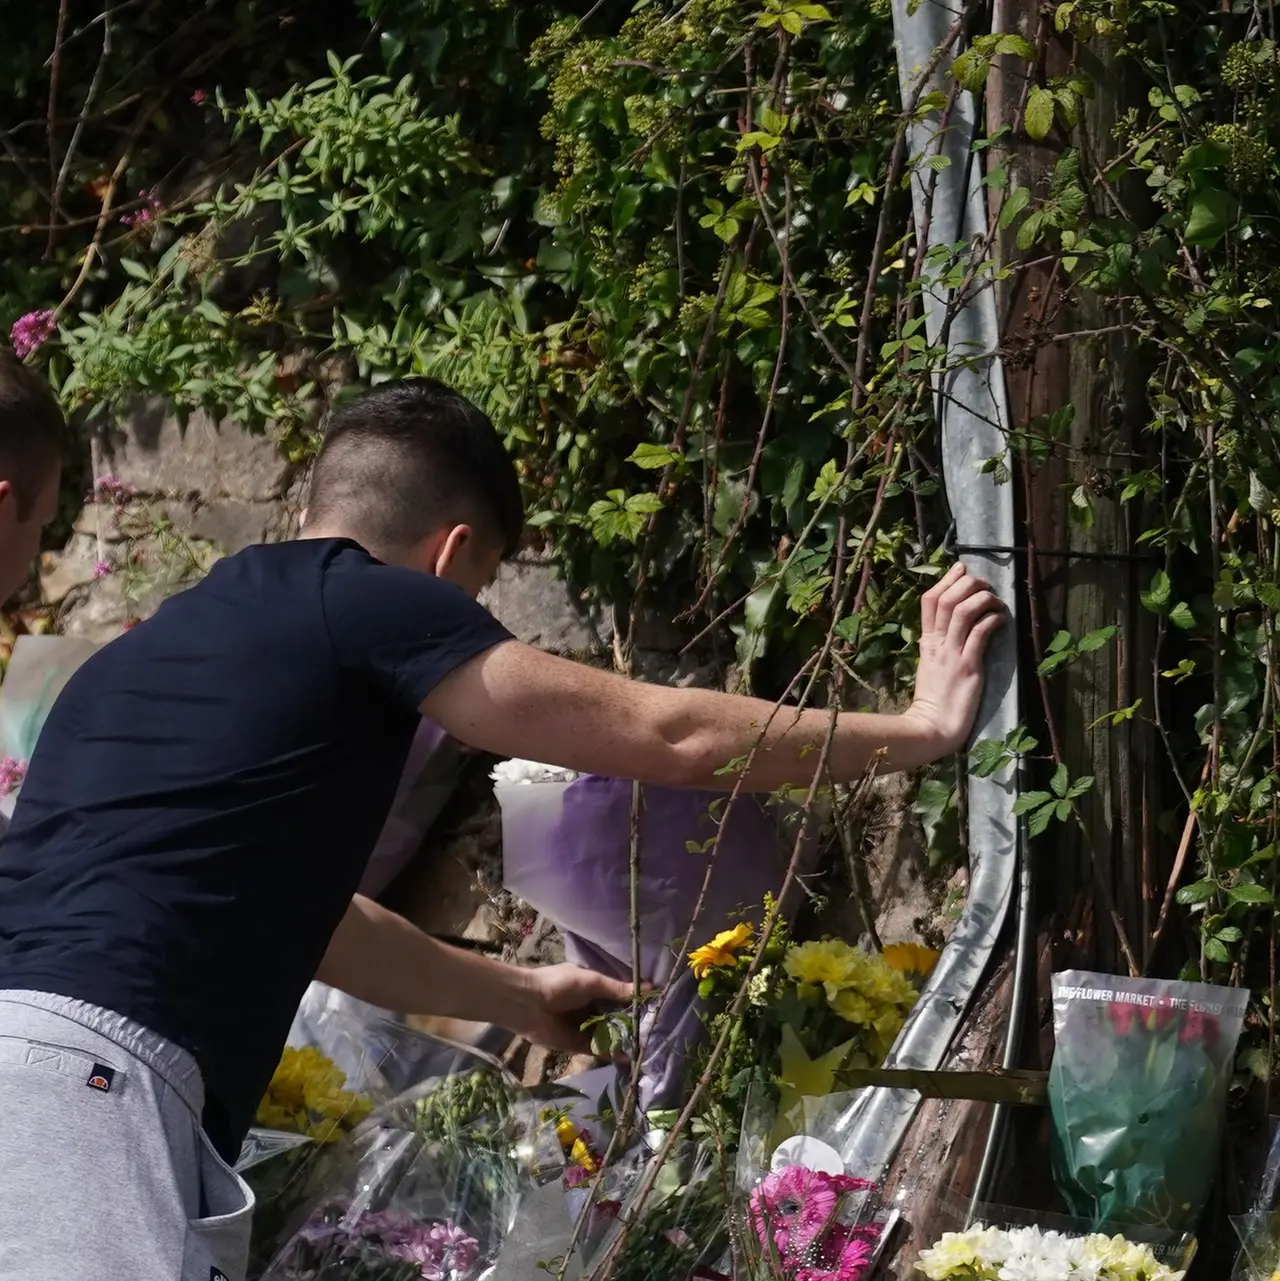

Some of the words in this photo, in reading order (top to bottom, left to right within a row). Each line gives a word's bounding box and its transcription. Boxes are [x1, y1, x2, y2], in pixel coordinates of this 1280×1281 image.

[1074, 987, 1113, 1002] FLOWER
[1115, 991, 1156, 1007] MARKET
[1169, 997, 1188, 1011] THE
